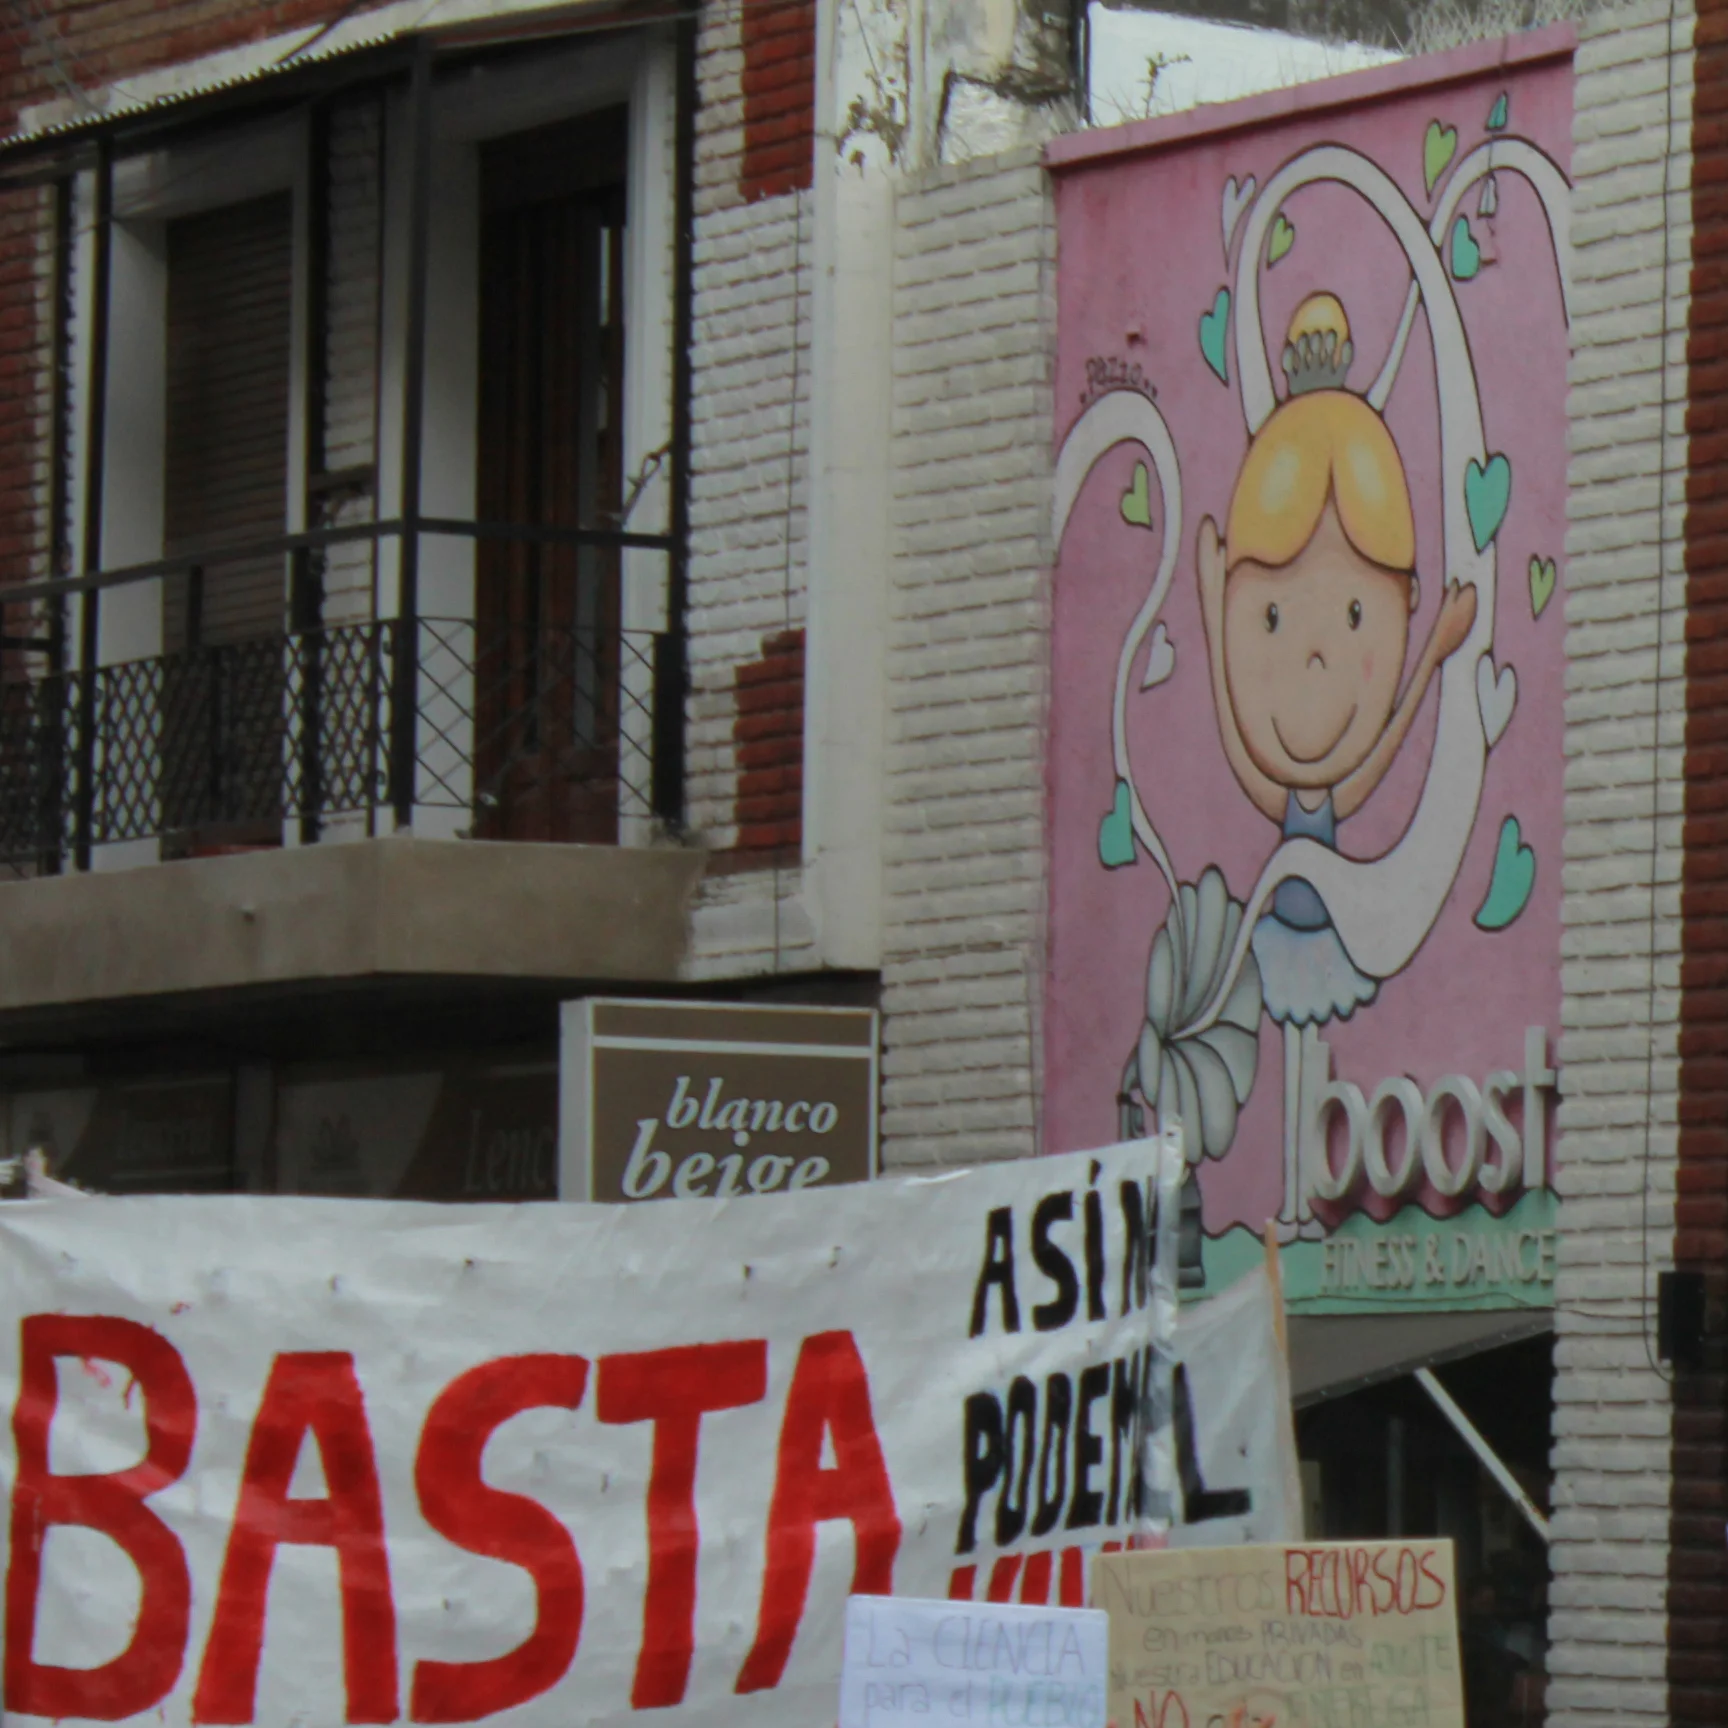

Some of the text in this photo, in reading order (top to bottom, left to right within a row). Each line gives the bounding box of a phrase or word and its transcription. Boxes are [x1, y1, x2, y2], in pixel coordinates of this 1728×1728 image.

[666, 1076, 839, 1137] blanco
[1313, 1025, 1557, 1201] boost
[621, 1118, 831, 1200] beige
[1320, 1237, 1418, 1292] FITNESS
[1450, 1227, 1556, 1285] DANCE
[4, 1311, 901, 1726] BASTA
[1283, 1547, 1446, 1621] RECURSOS
[865, 1610, 1085, 1676] La CIENCIA
[1142, 1625, 1180, 1653] en
[1262, 1618, 1364, 1649] PRIVADAS
[864, 1681, 931, 1728] para
